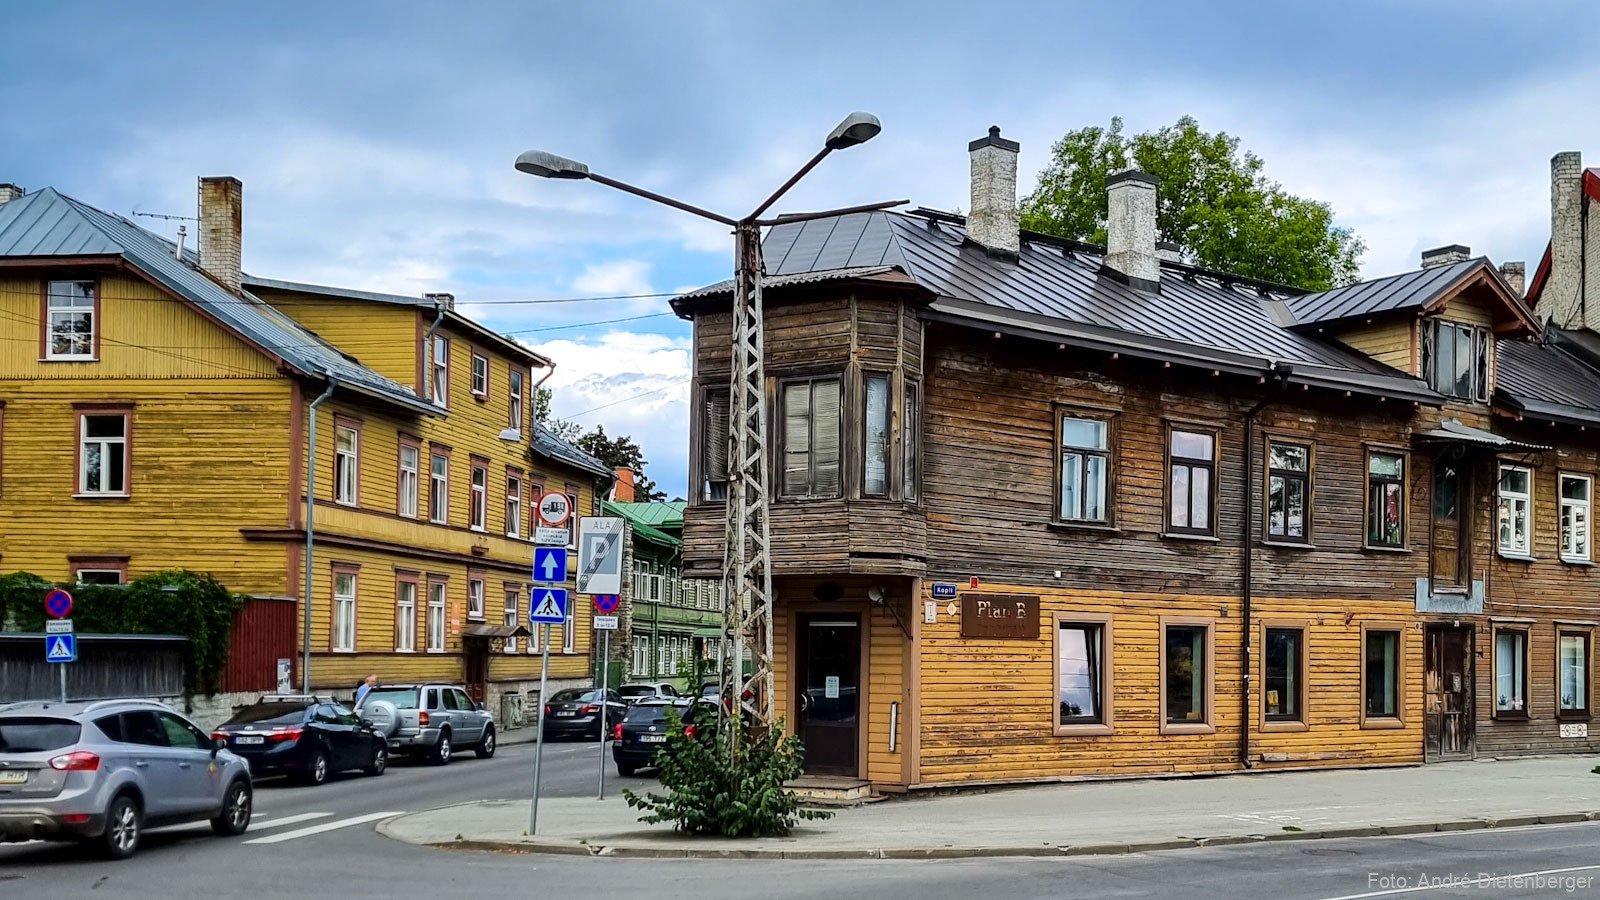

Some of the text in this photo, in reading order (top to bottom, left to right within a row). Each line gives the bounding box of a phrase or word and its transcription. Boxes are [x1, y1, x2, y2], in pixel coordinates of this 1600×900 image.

[593, 521, 611, 530] ALA
[936, 587, 953, 595] Kopli
[977, 601, 1027, 619] Plan B
